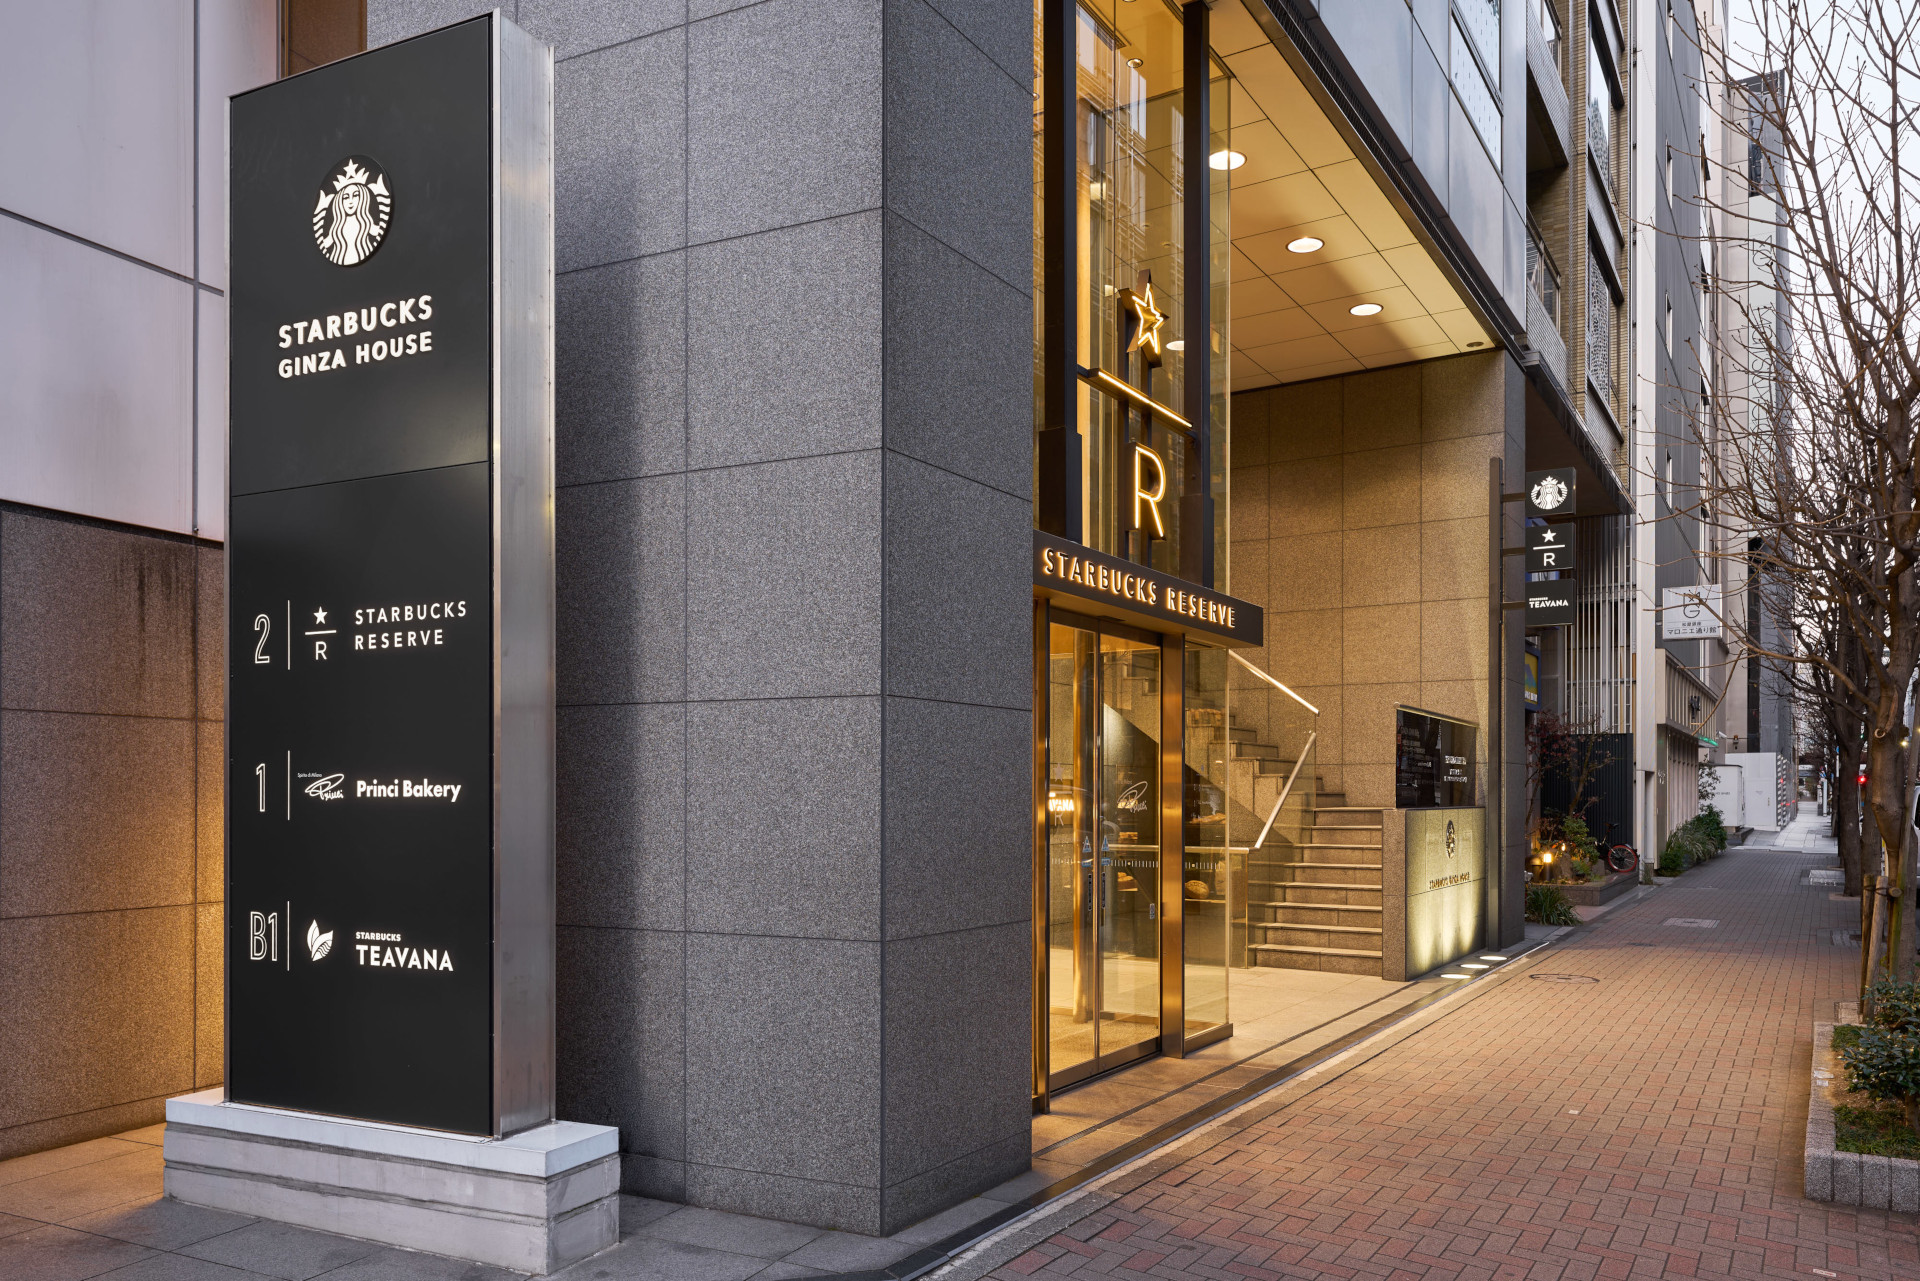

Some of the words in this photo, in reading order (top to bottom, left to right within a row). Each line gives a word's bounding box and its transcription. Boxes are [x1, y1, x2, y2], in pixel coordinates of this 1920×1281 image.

[278, 294, 433, 349] STARBUCKS
[278, 349, 346, 379] GINZA
[355, 331, 432, 364] HOUSE
[1134, 444, 1166, 539] R
[1543, 552, 1556, 567] R
[1042, 547, 1158, 605] STARBUCKS
[1166, 586, 1236, 628] RESERVE
[354, 600, 467, 625] STARBUCKS
[1529, 599, 1569, 608] TEAVANA
[254, 613, 271, 664] 2
[315, 640, 328, 661] R
[354, 628, 444, 651] RESERVE
[255, 762, 266, 813] 1
[356, 778, 399, 798] Princi
[402, 777, 462, 803] Bakery
[250, 911, 278, 962] B1
[355, 931, 401, 942] STARBUCKS
[355, 944, 454, 972] TEAVANA
